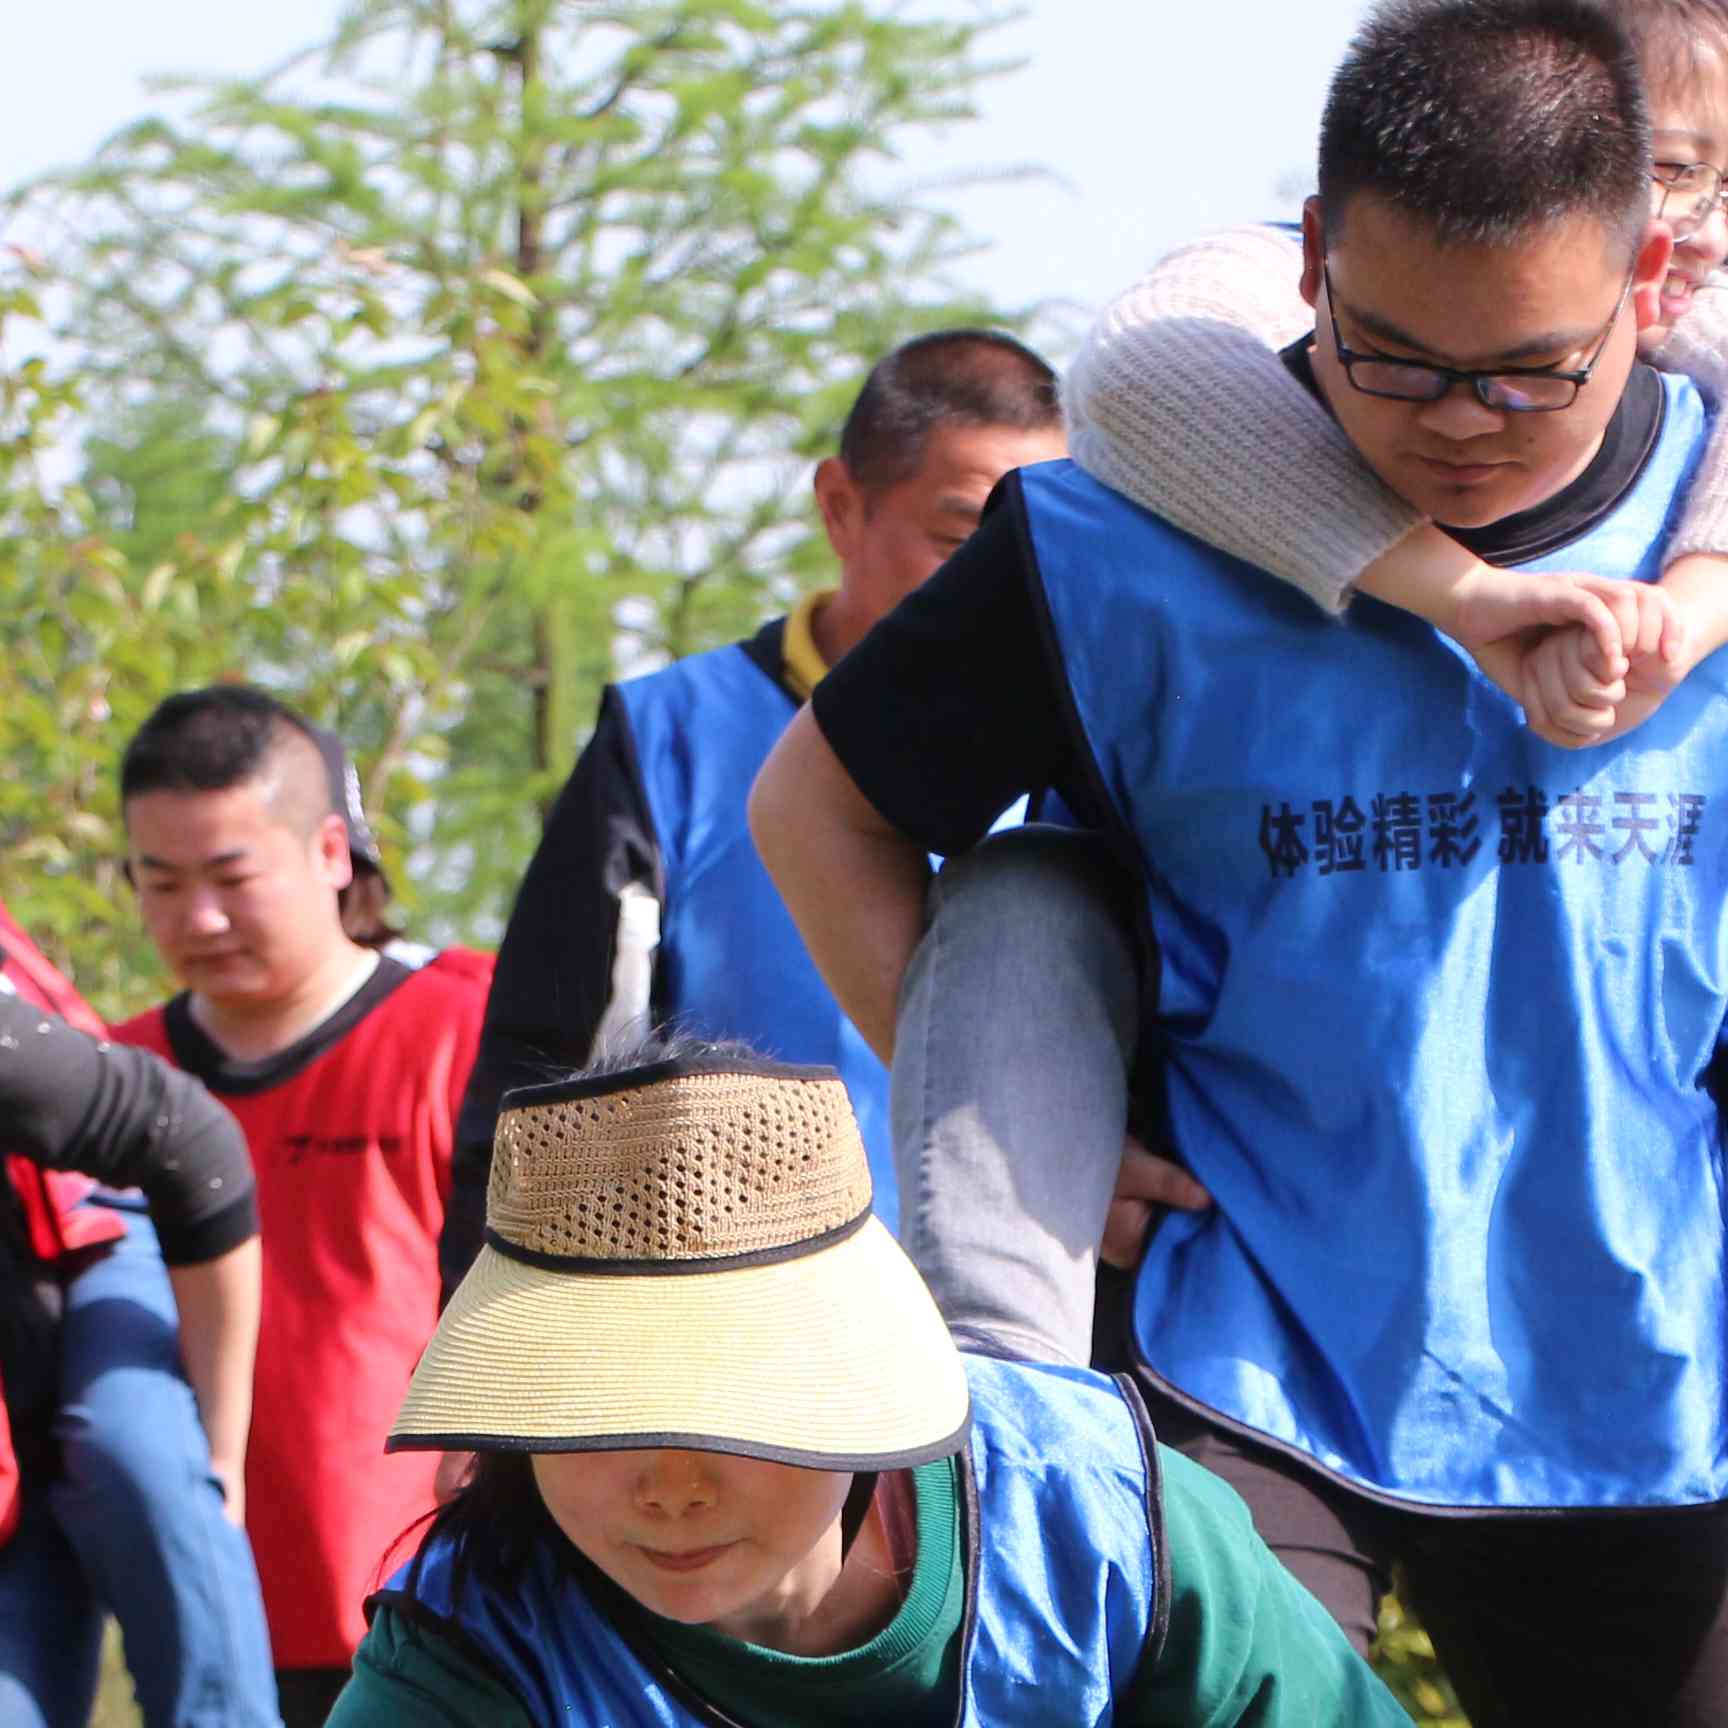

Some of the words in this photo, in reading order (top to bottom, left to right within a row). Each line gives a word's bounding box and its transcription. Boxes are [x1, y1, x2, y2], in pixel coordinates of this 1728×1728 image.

[1258, 790, 1482, 878] 体验精彩
[1497, 785, 1706, 865] 就来天涯
